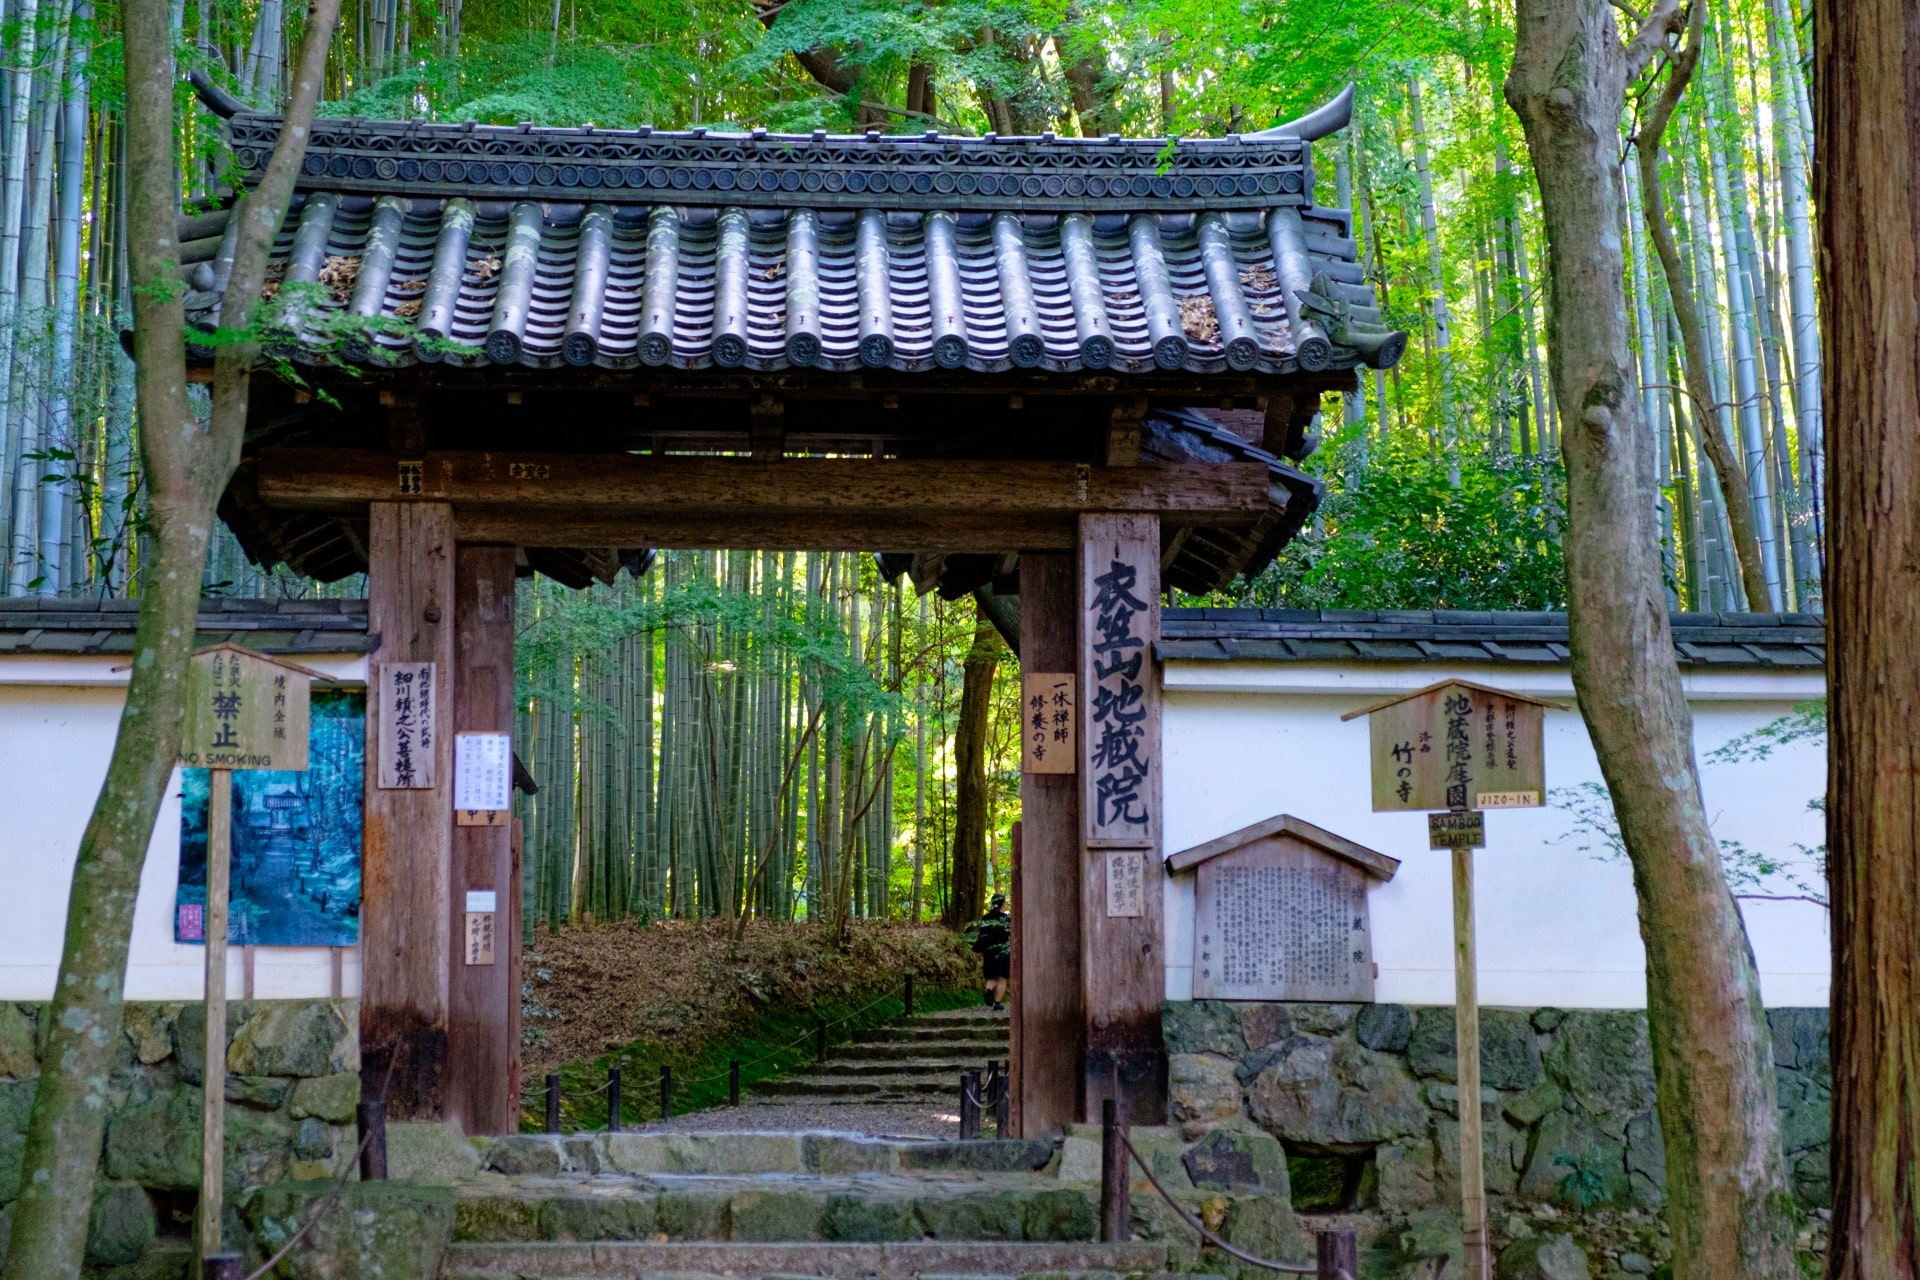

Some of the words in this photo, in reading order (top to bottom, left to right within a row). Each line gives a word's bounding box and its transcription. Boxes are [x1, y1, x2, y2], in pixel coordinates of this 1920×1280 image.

[213, 653, 224, 687] たばこ
[229, 655, 241, 688] たき火
[211, 690, 242, 749] 禁止
[272, 674, 287, 739] 境内全域
[394, 670, 416, 788] 細川頼之公菩提所
[418, 667, 431, 749] 南北朝時代の武将
[1030, 695, 1047, 763] 修養の寺
[1052, 682, 1073, 744] 一休禅師
[177, 752, 199, 764] NO
[206, 754, 271, 767] SMOKING
[1390, 741, 1416, 804] 竹の寺
[1444, 692, 1473, 808] 地蔵院庭園
[1432, 816, 1481, 830] BAMBOO
[1480, 794, 1531, 805] JIZO-IN
[1432, 833, 1482, 848] TEMPLE
[1352, 886, 1365, 964] 地蔵院
[1201, 935, 1212, 980] 京都市
